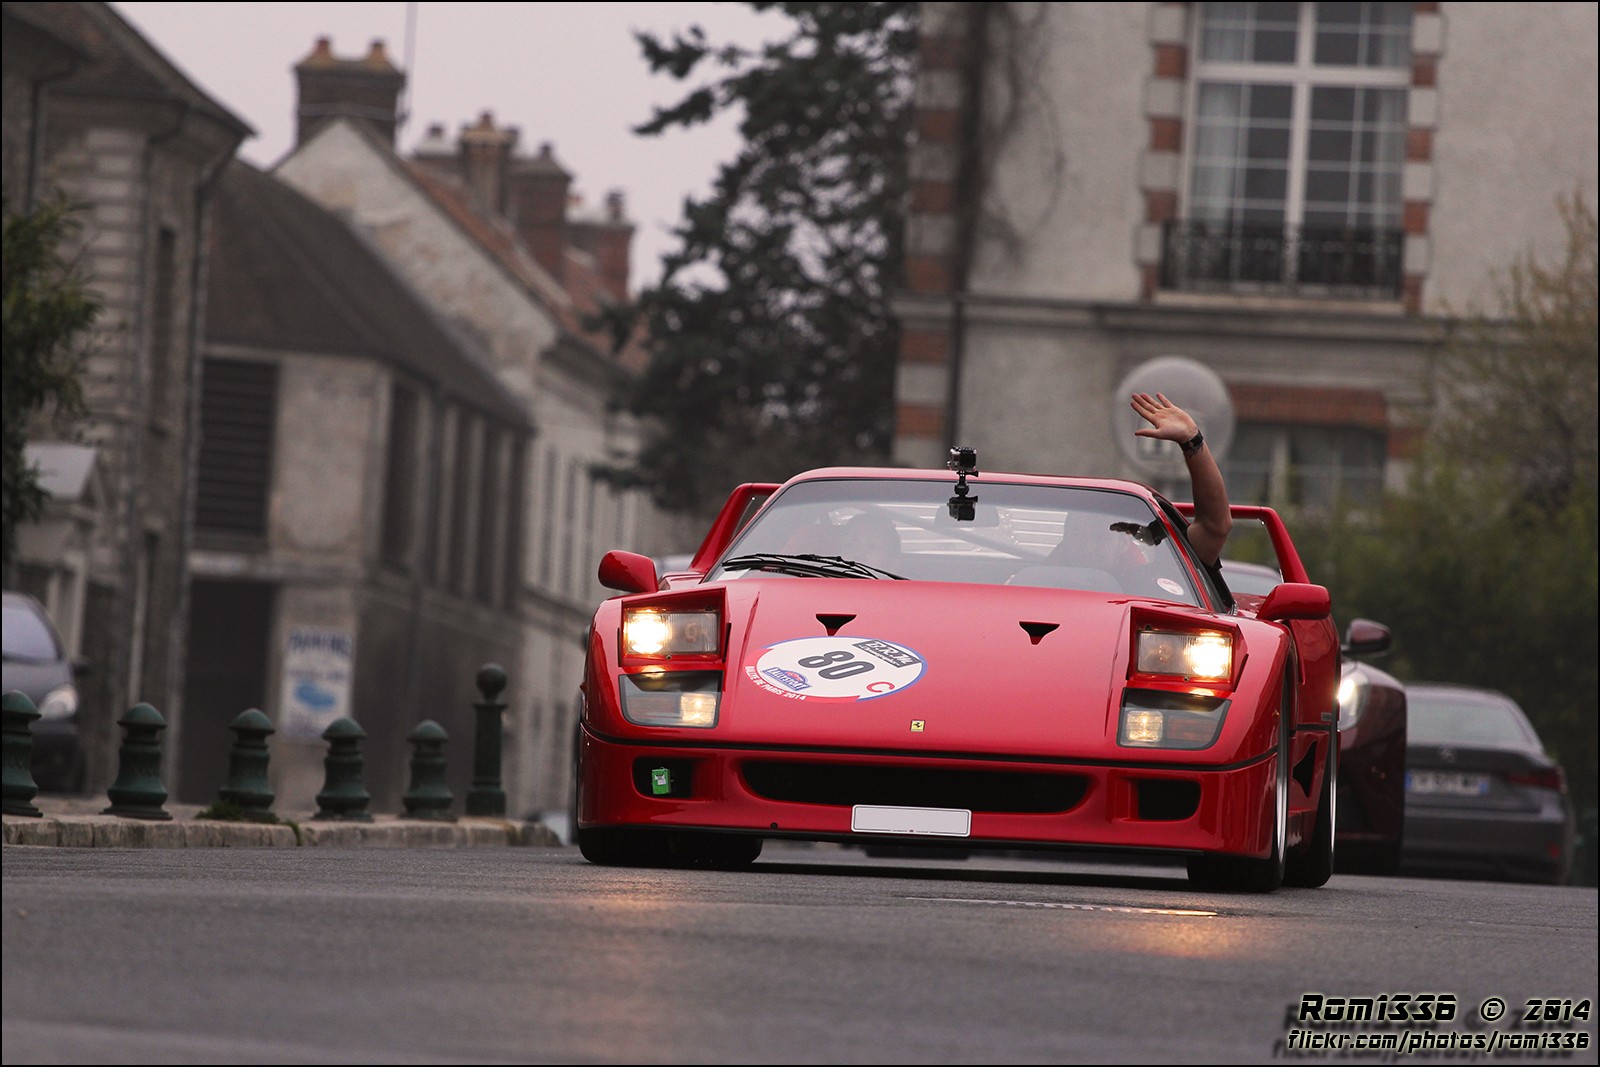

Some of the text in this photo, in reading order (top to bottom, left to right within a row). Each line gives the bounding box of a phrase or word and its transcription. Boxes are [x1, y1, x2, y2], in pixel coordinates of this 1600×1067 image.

[798, 651, 875, 679] 80
[761, 684, 785, 695] PARIS
[866, 681, 895, 693] C
